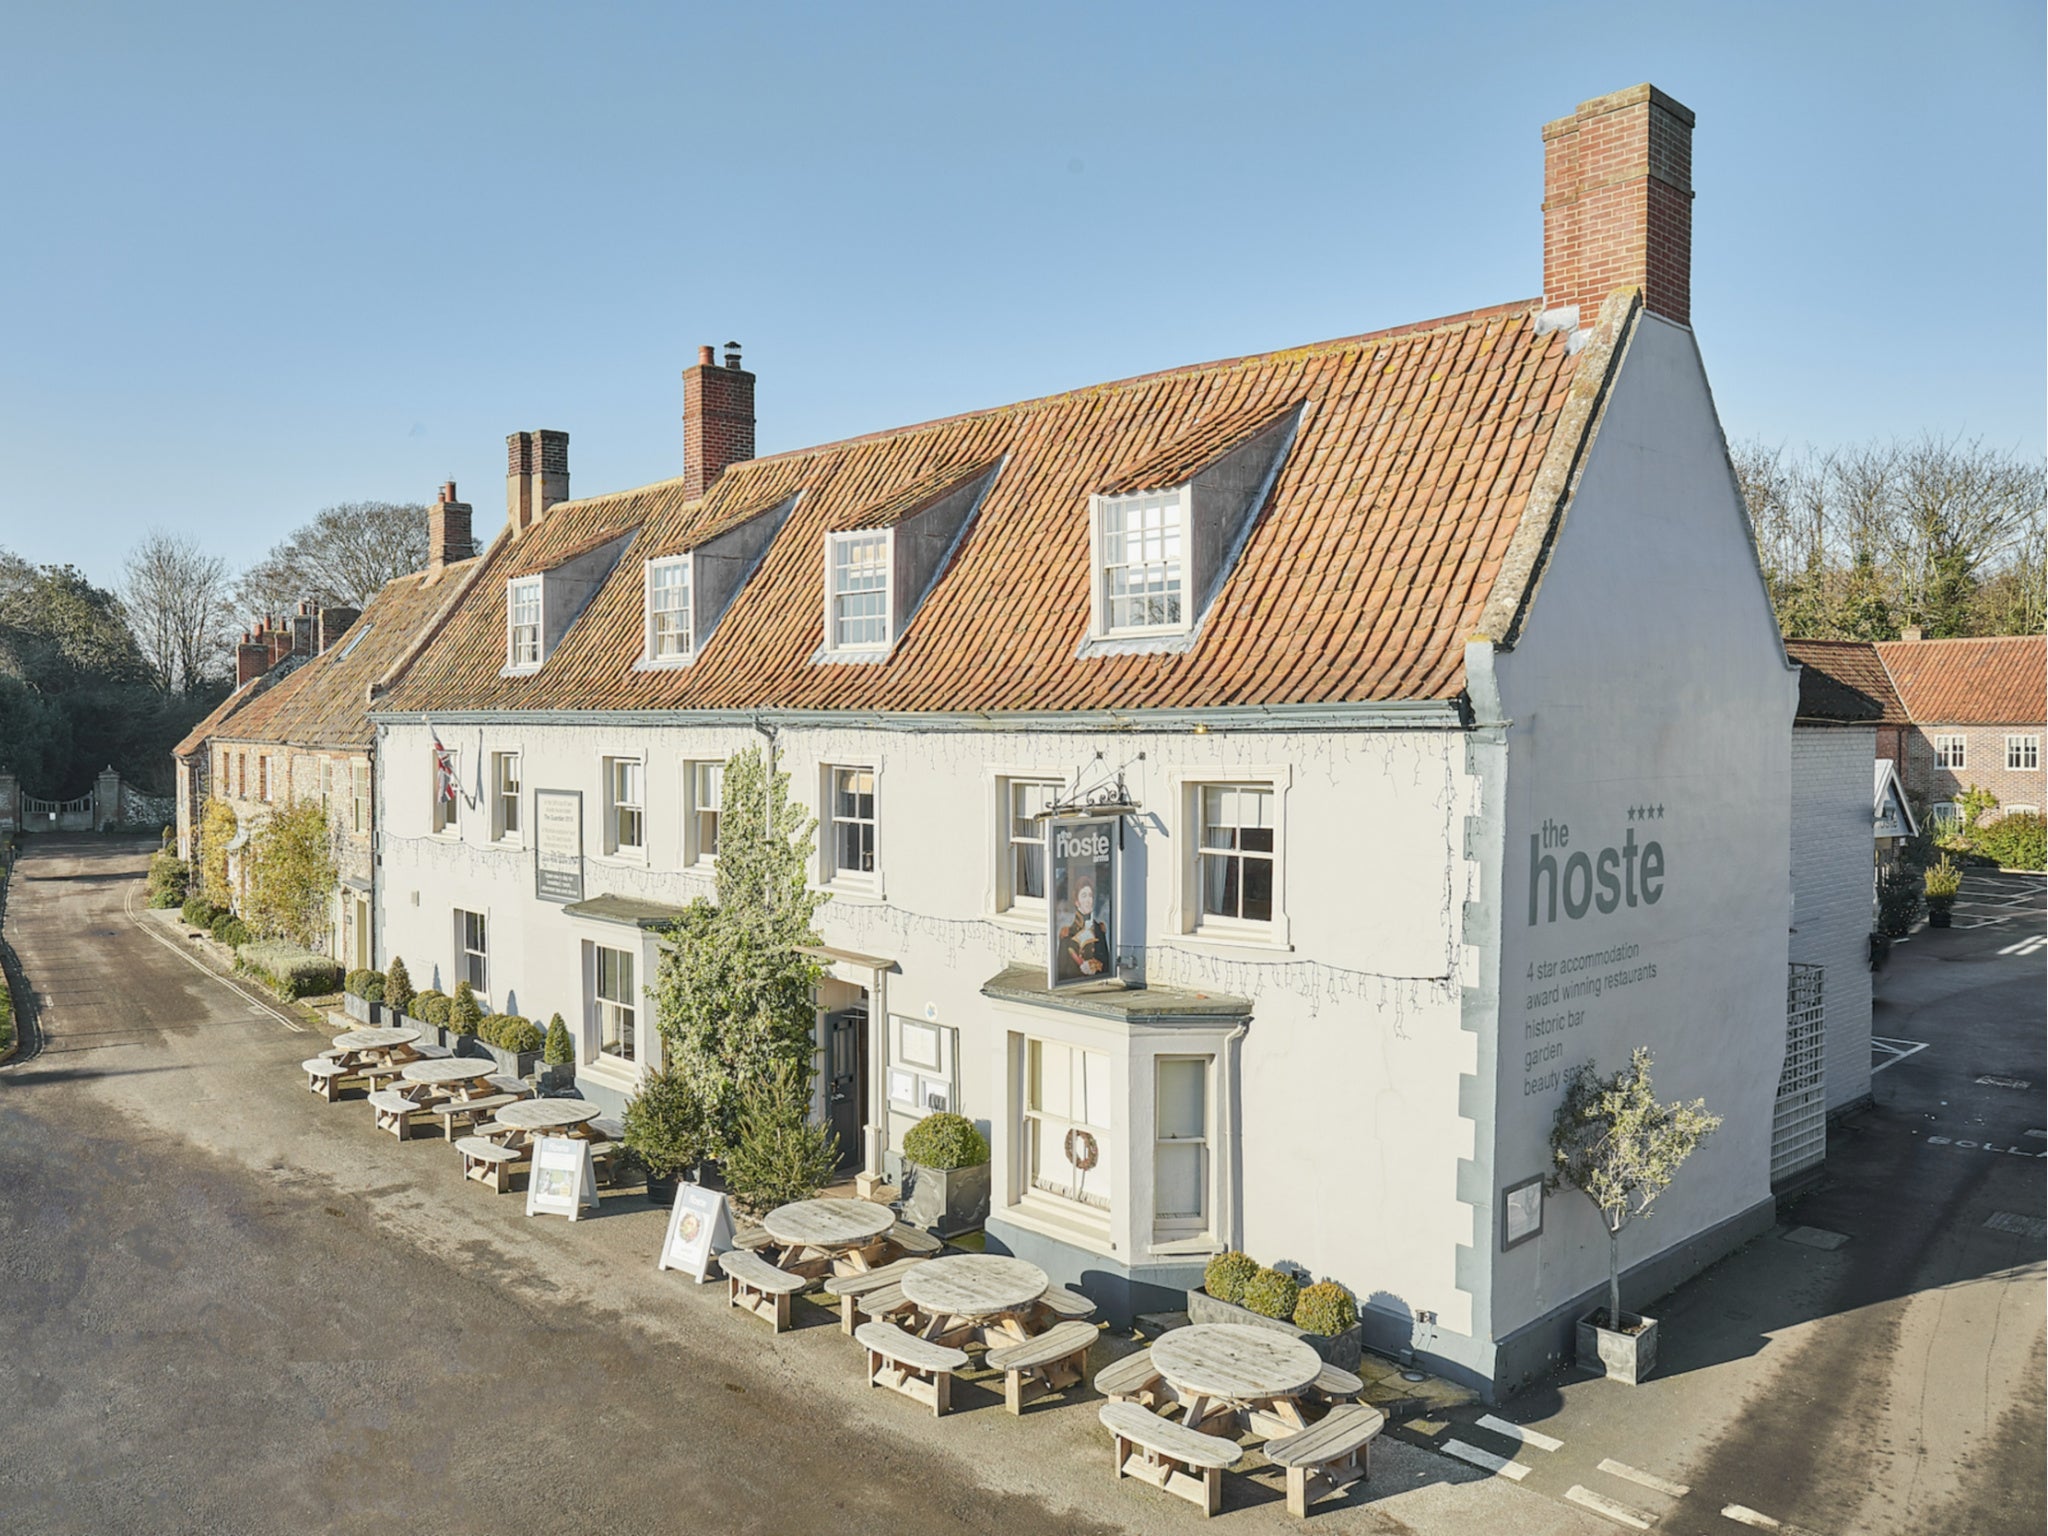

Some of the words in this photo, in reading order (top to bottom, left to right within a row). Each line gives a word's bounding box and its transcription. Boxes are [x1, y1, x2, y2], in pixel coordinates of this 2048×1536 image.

[1057, 832, 1110, 858] hoste
[1542, 818, 1569, 849] the
[1528, 828, 1665, 927] hoste
[1526, 961, 1534, 982] 4
[1537, 961, 1558, 980] star
[1560, 942, 1639, 975] accommodation
[1526, 984, 1559, 1011] award
[1562, 976, 1601, 1001] winning
[1604, 964, 1657, 990] restaurants
[1525, 1013, 1565, 1040] historic
[1567, 1010, 1585, 1028] bar
[1525, 1042, 1563, 1072] garden
[1524, 1069, 1560, 1096] beauty
